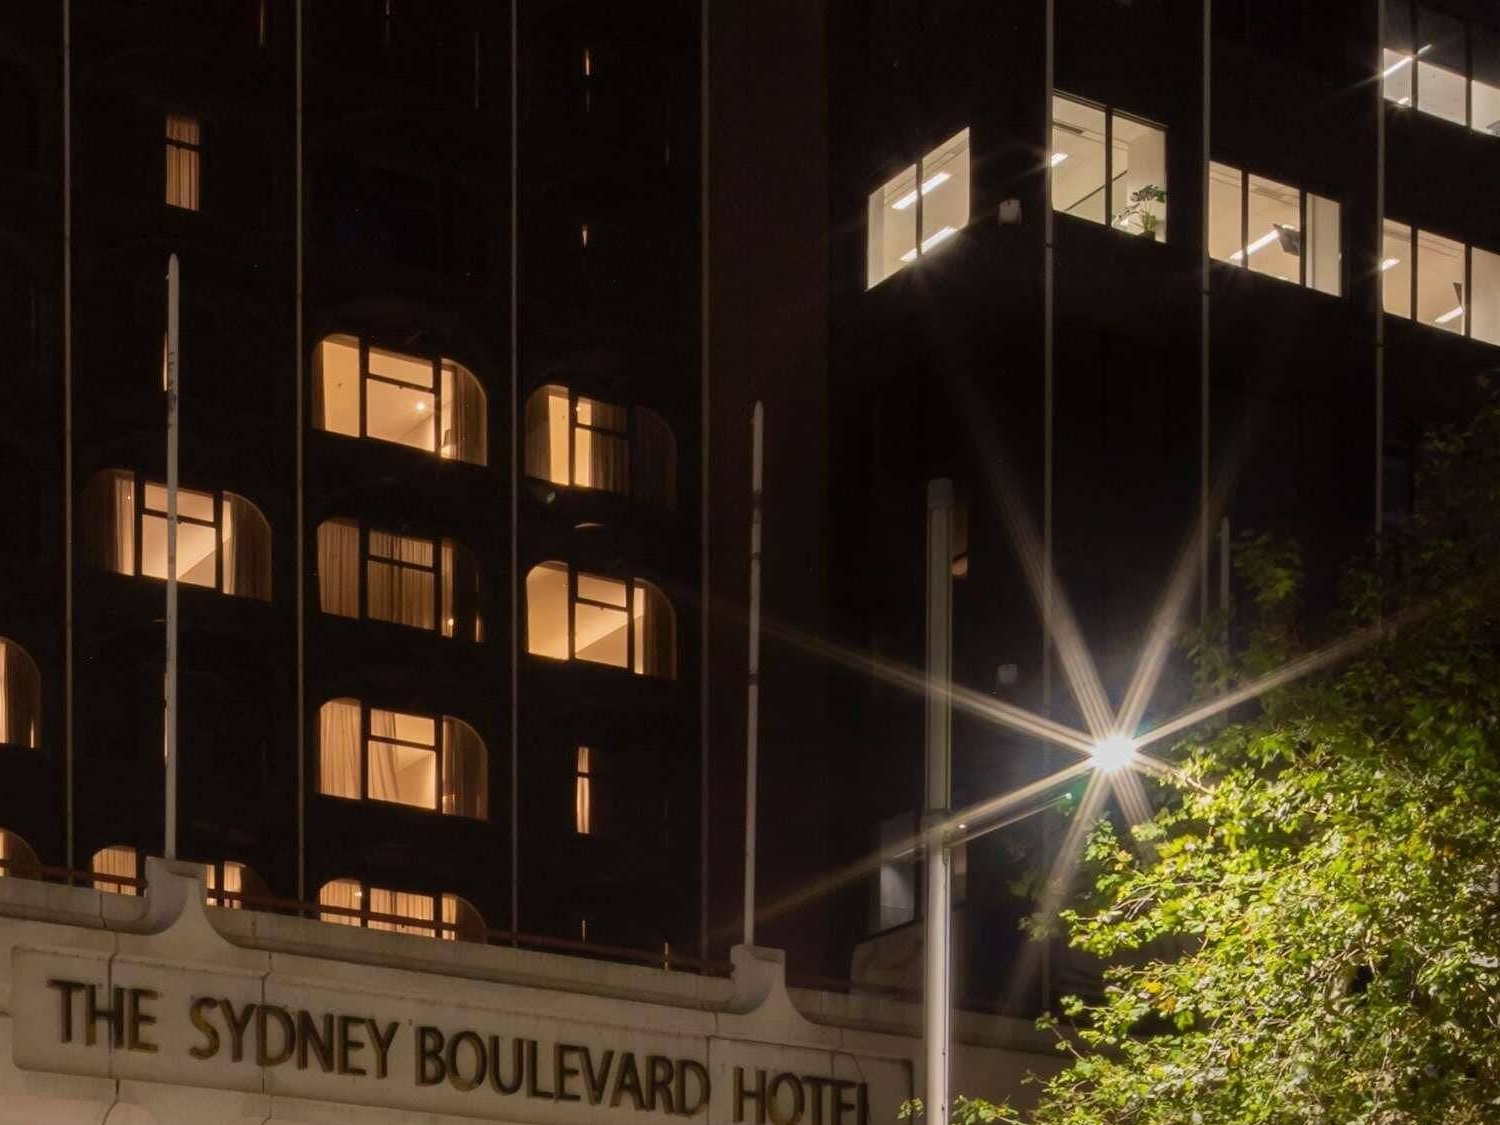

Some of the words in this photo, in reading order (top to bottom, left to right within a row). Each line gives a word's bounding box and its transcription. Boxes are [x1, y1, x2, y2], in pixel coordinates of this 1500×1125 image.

[47, 979, 159, 1053] THE
[188, 996, 400, 1080] SYDNEY
[414, 1025, 711, 1117] BOULEVARD
